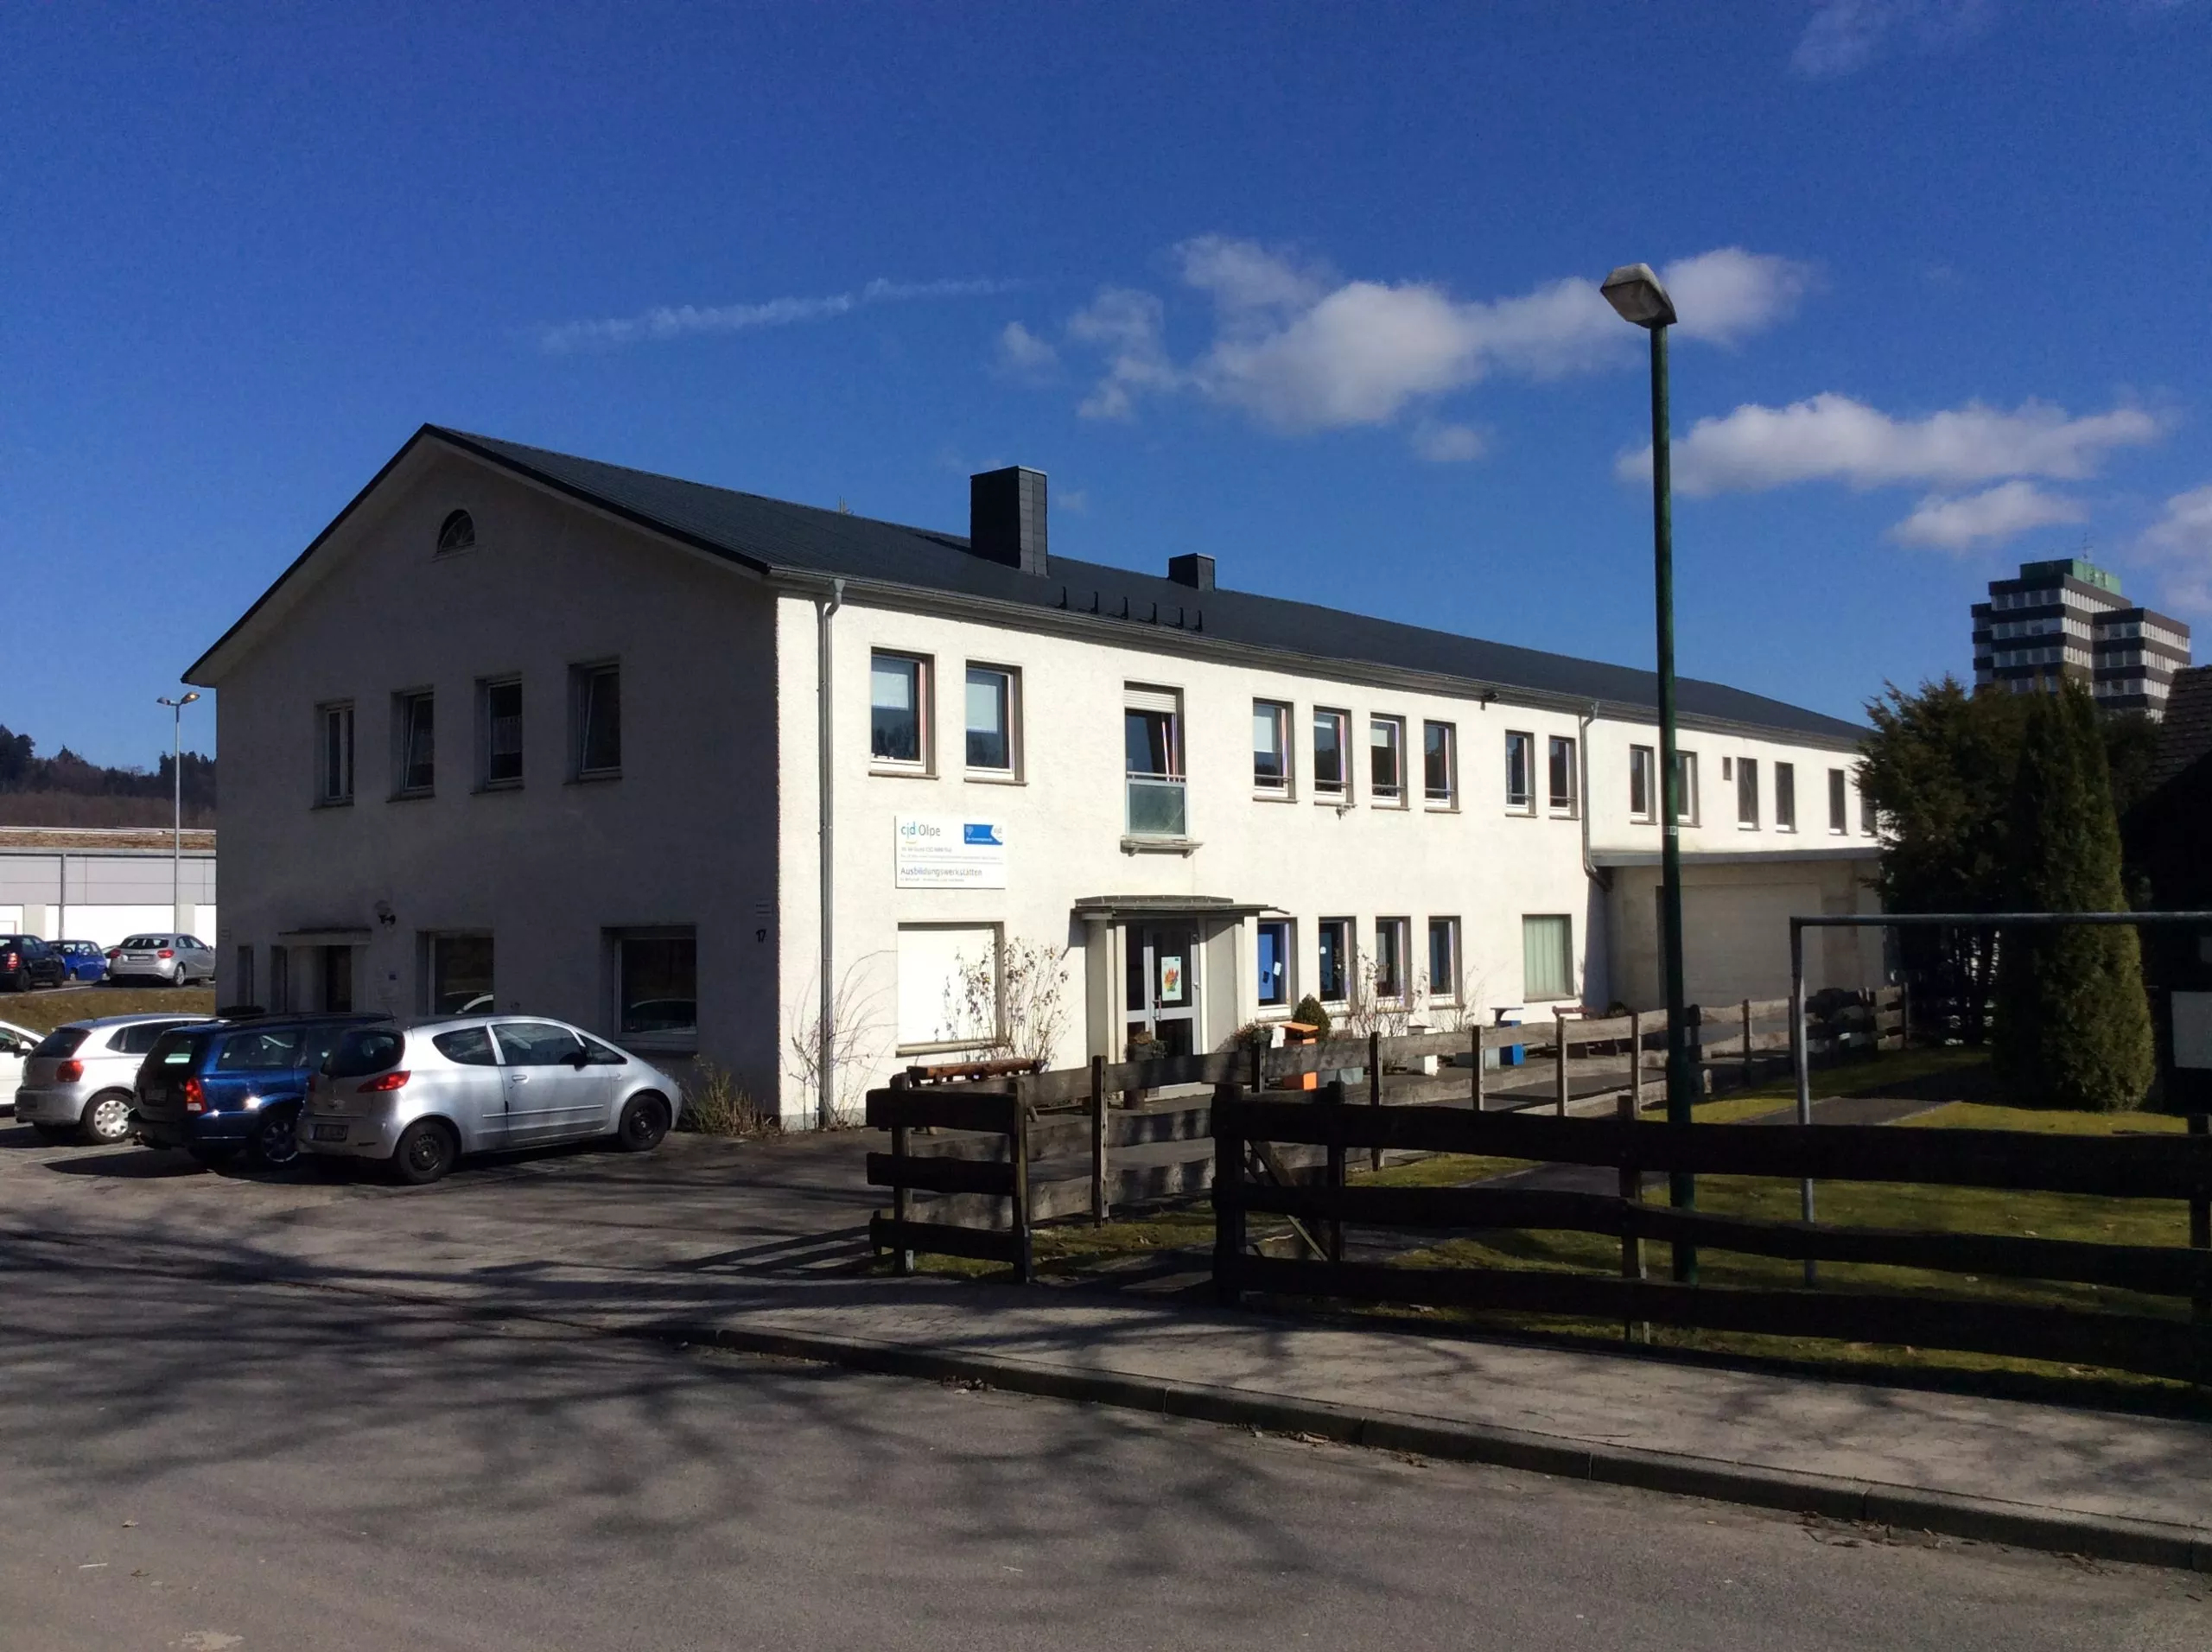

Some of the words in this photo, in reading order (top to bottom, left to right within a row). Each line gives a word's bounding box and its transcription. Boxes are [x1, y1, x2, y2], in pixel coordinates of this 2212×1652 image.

[900, 821, 916, 840] cjd
[918, 823, 941, 839] Olpe
[755, 929, 767, 943] 17
